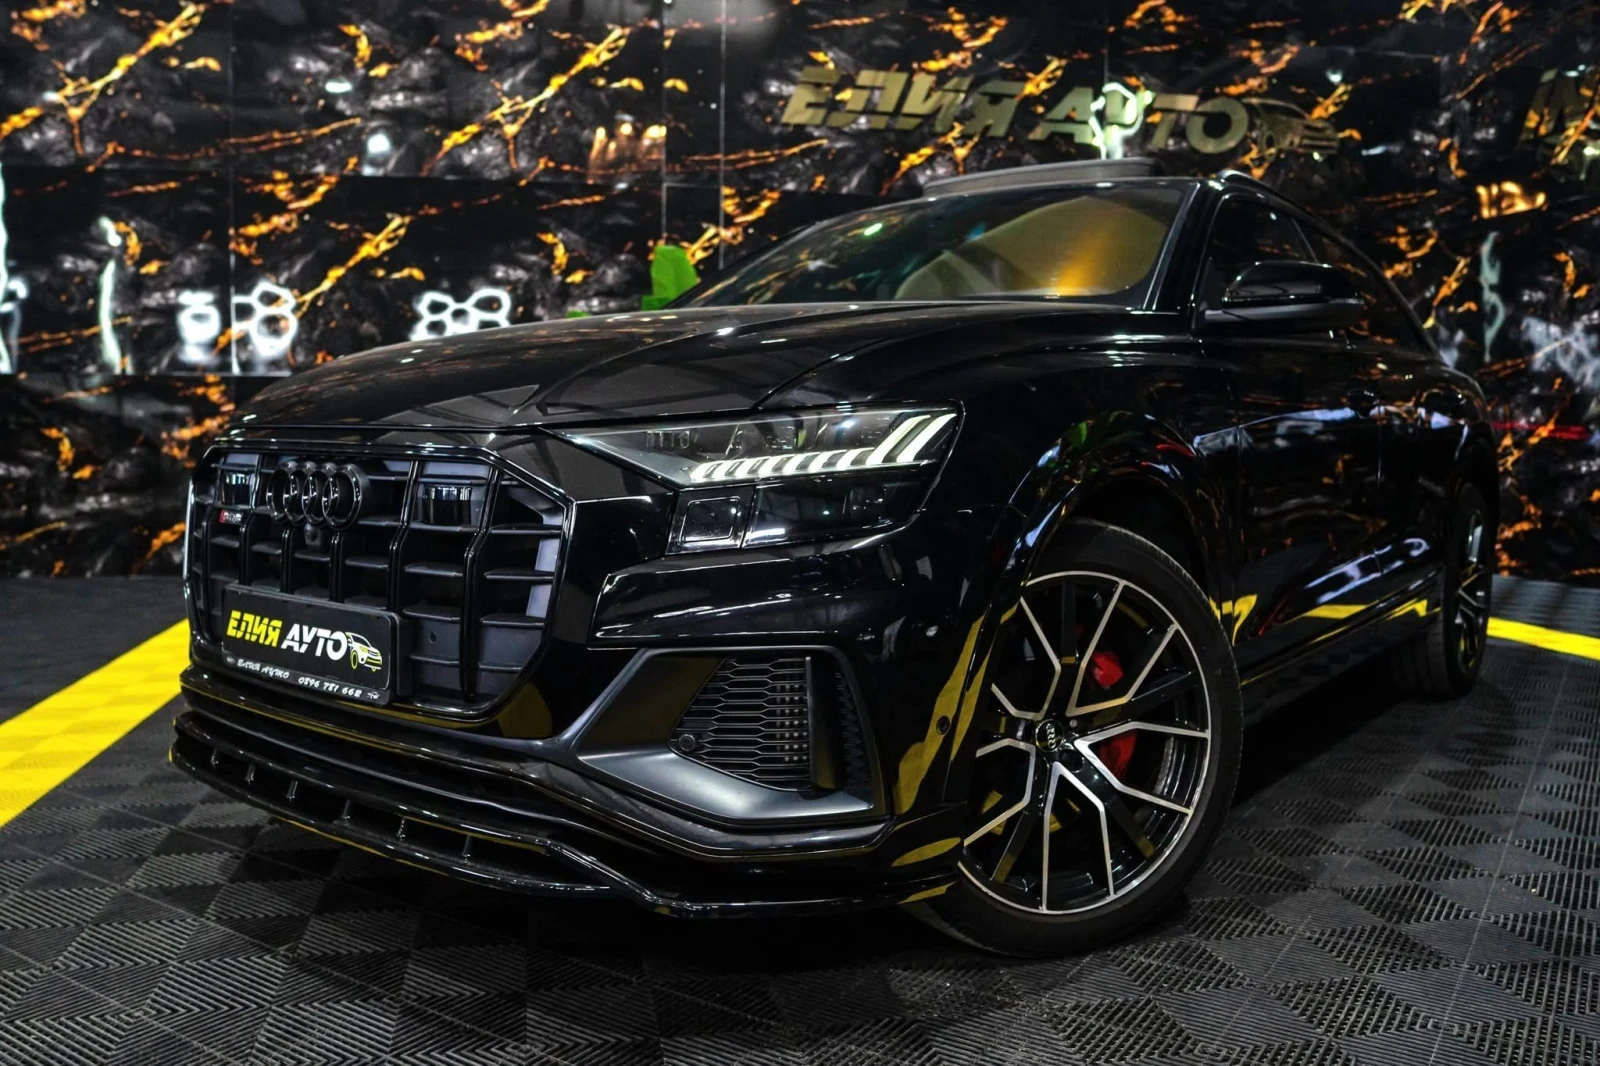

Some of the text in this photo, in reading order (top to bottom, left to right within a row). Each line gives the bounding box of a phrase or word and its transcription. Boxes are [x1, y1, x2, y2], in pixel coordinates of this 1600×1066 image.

[226, 610, 348, 661] ЕЛИЯ АУТО
[298, 676, 321, 688] 0896
[323, 682, 340, 693] 781
[341, 687, 362, 698] 662
